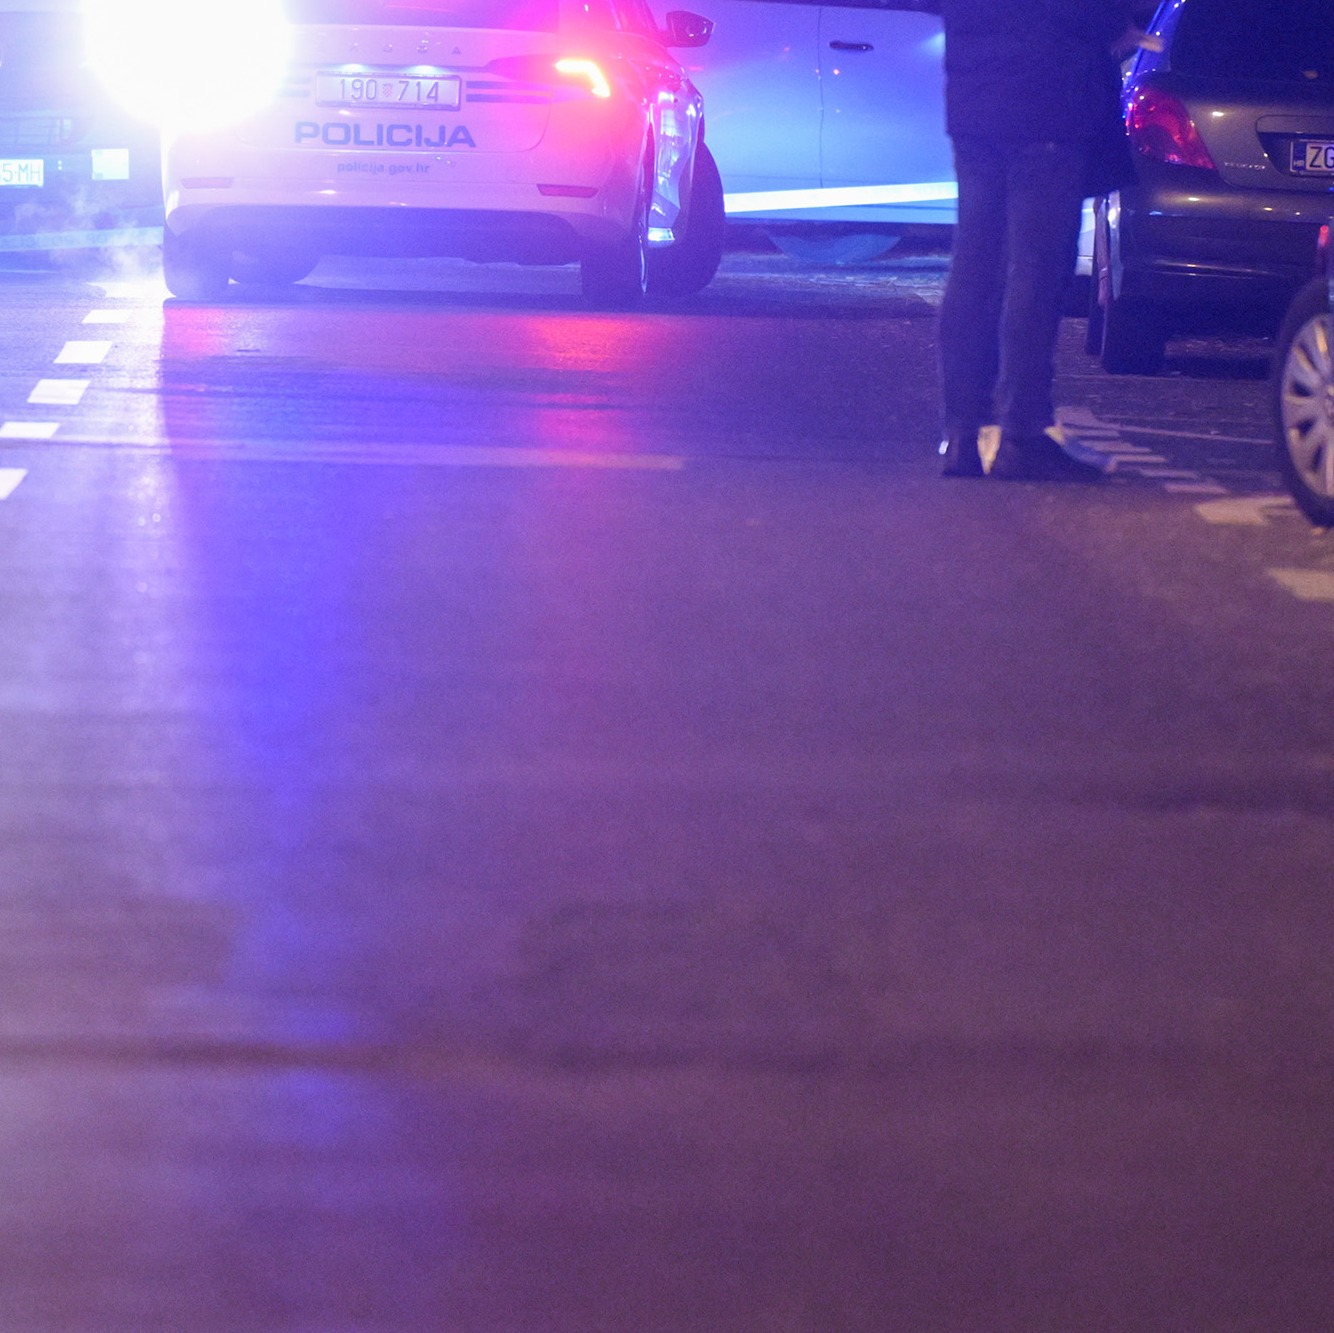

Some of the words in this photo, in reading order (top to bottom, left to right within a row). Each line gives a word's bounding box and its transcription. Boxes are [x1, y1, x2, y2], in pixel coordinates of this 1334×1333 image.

[339, 78, 377, 100] 190
[397, 80, 440, 102] 714
[294, 121, 477, 148] POLICIJA
[336, 161, 431, 176] policija.gov.hr
